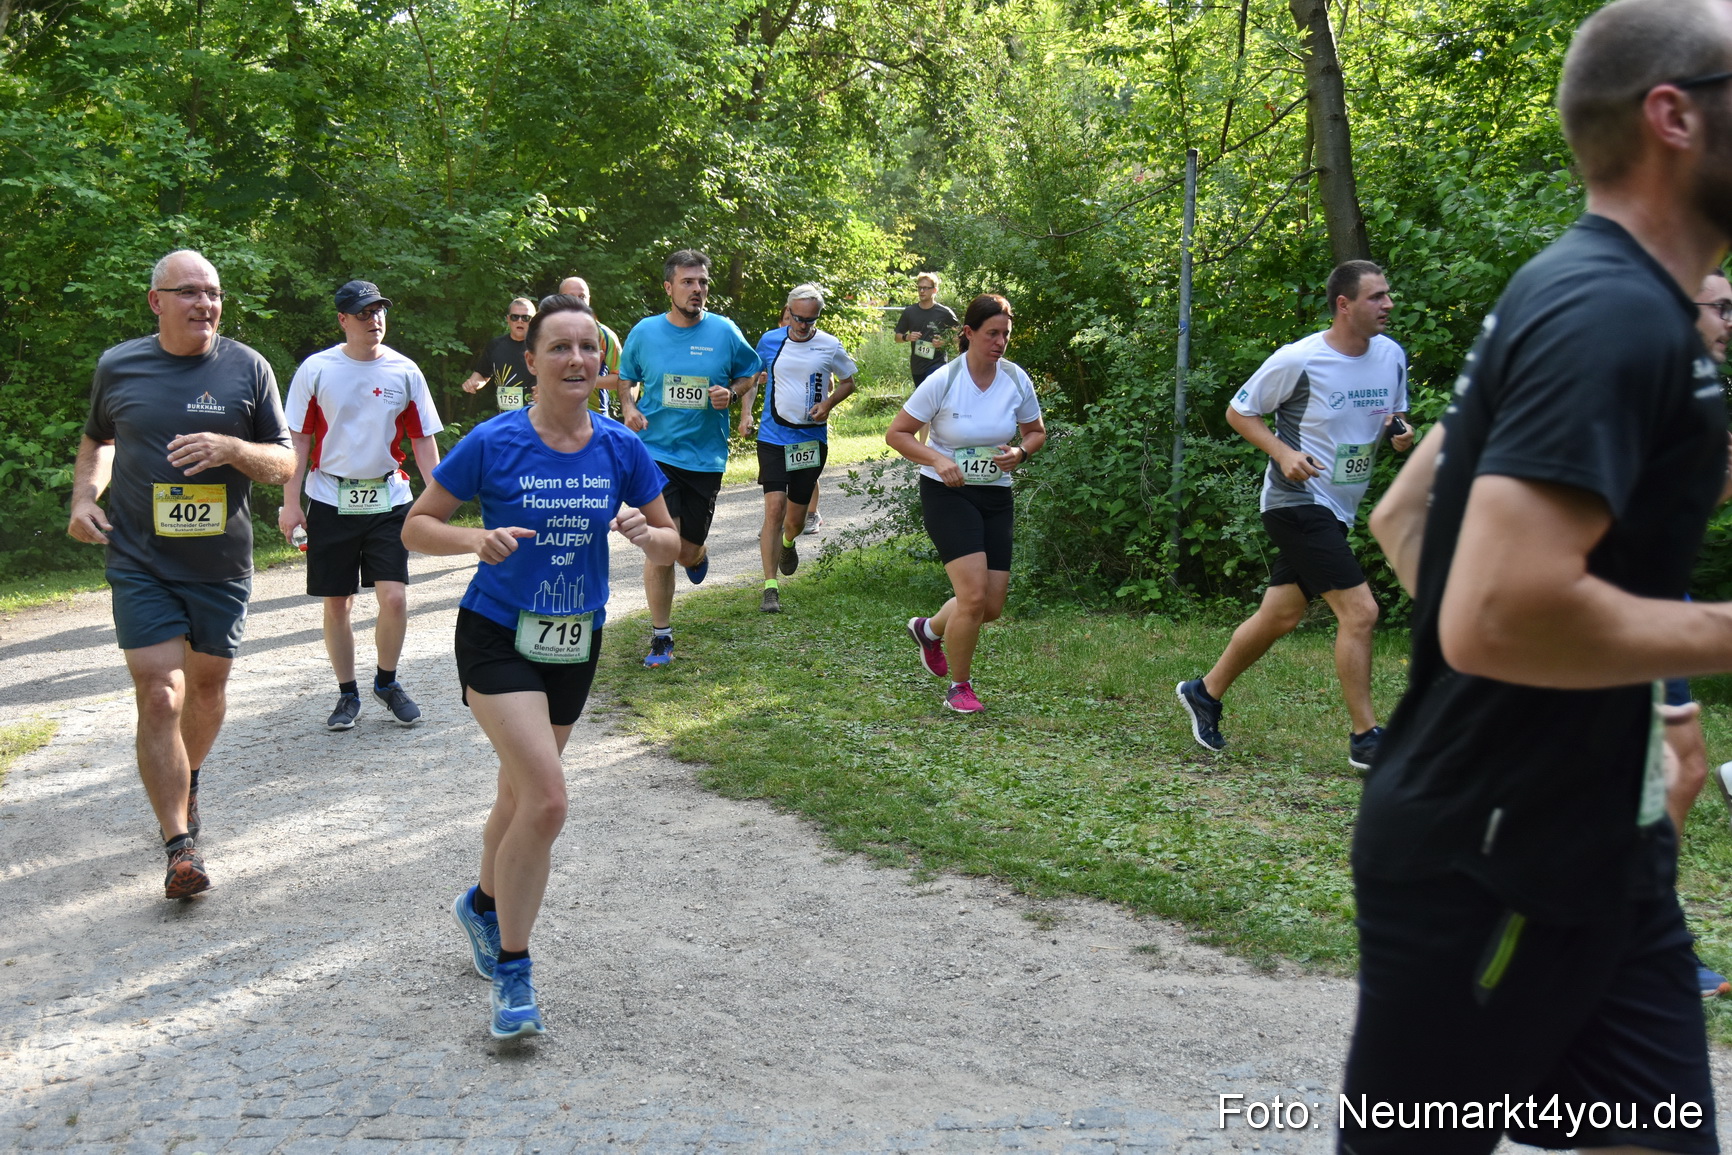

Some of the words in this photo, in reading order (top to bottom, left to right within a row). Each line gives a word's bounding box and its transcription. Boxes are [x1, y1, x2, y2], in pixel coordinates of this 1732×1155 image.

[917, 346, 930, 354] 419
[499, 395, 519, 404] 1755
[668, 386, 703, 401] 1850
[1347, 388, 1389, 399] HAUBNER
[186, 403, 226, 411] BURKHARDT
[1353, 399, 1385, 408] TREPPEN
[789, 450, 816, 463] 1057
[962, 459, 998, 474] 1475
[1345, 457, 1370, 474] 989
[519, 475, 562, 490] Wenn
[565, 477, 580, 489] es
[582, 473, 611, 489] beim
[349, 489, 379, 504] 372
[522, 494, 609, 509] Hausverkauf
[169, 503, 211, 522] 402
[546, 514, 590, 531] richtig
[535, 532, 593, 547] LAUFEN
[550, 552, 575, 566] soll!
[538, 620, 582, 646] 719
[534, 644, 566, 653] Blendiger
